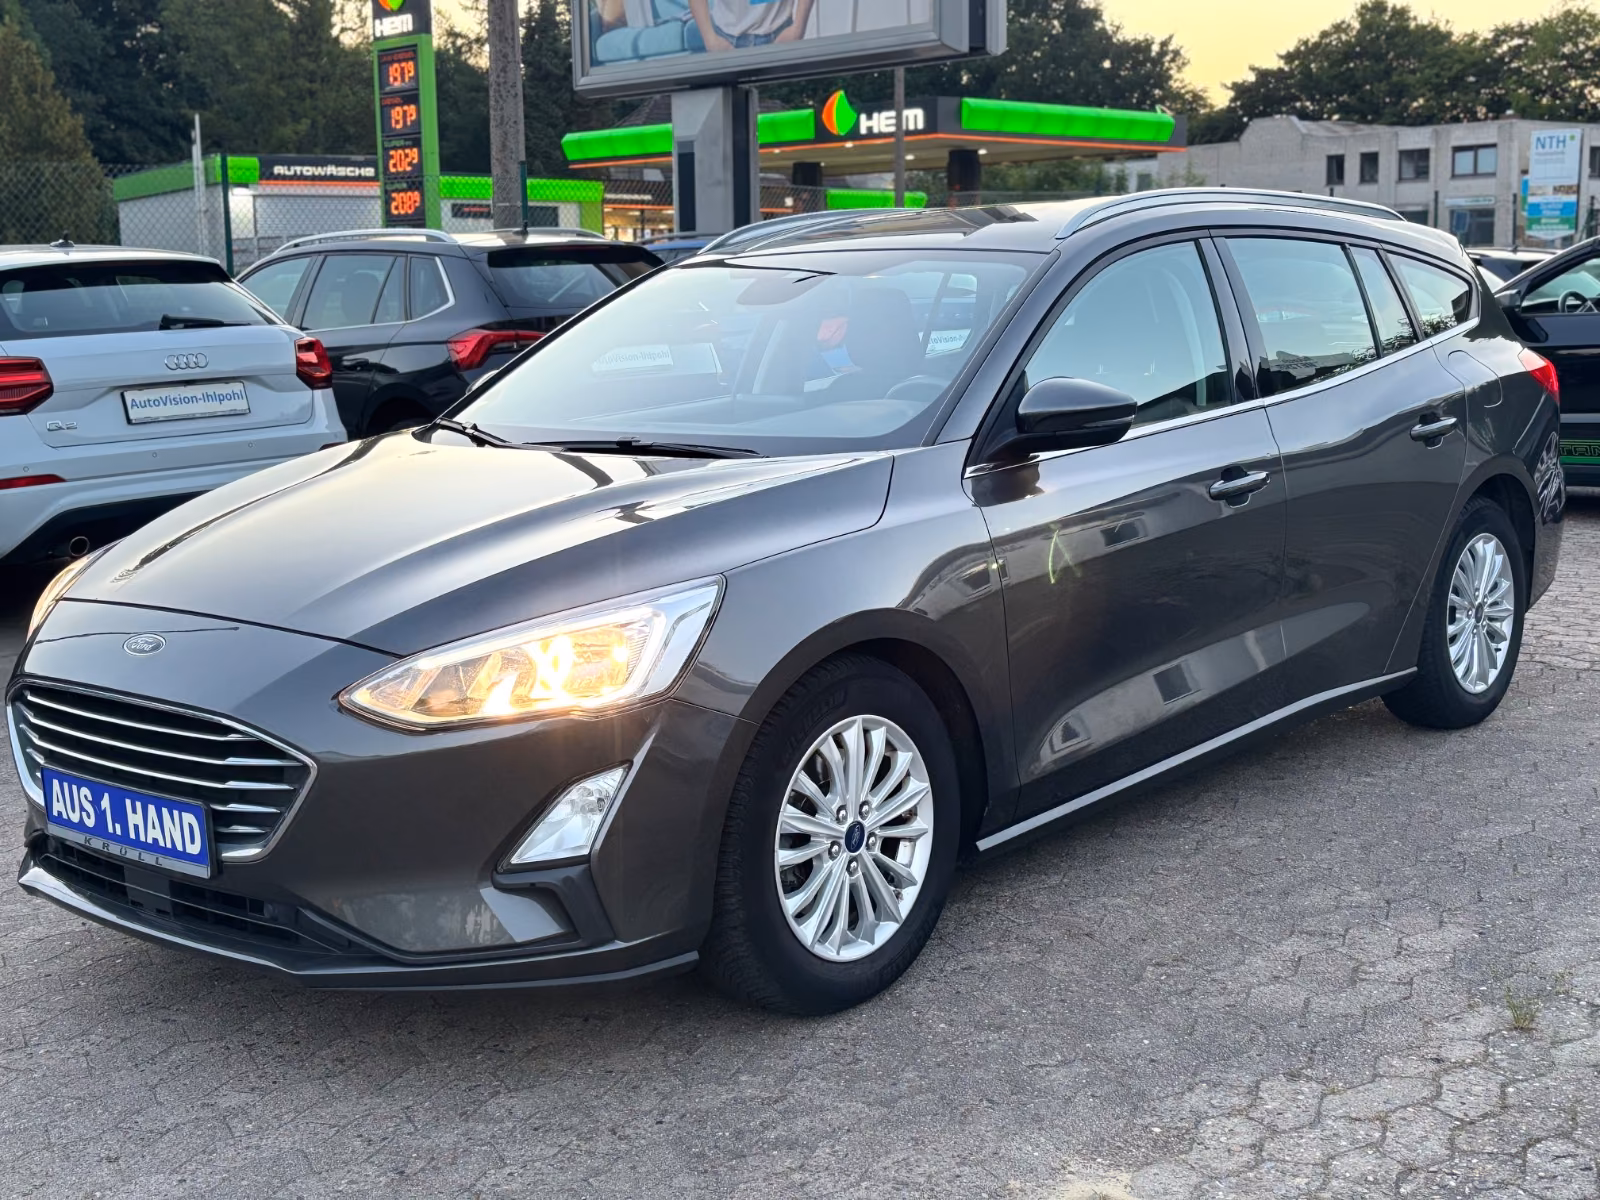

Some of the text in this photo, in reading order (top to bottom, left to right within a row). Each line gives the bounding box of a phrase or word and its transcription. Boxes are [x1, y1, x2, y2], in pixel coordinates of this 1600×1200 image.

[374, 13, 413, 37] HEM
[859, 108, 924, 135] HEM
[1535, 135, 1567, 150] NTH
[130, 389, 244, 410] AutoVision-Ihlpohl
[47, 420, 77, 432] Q2
[129, 638, 156, 651] Ford
[52, 778, 201, 855] AUS 1. HAND
